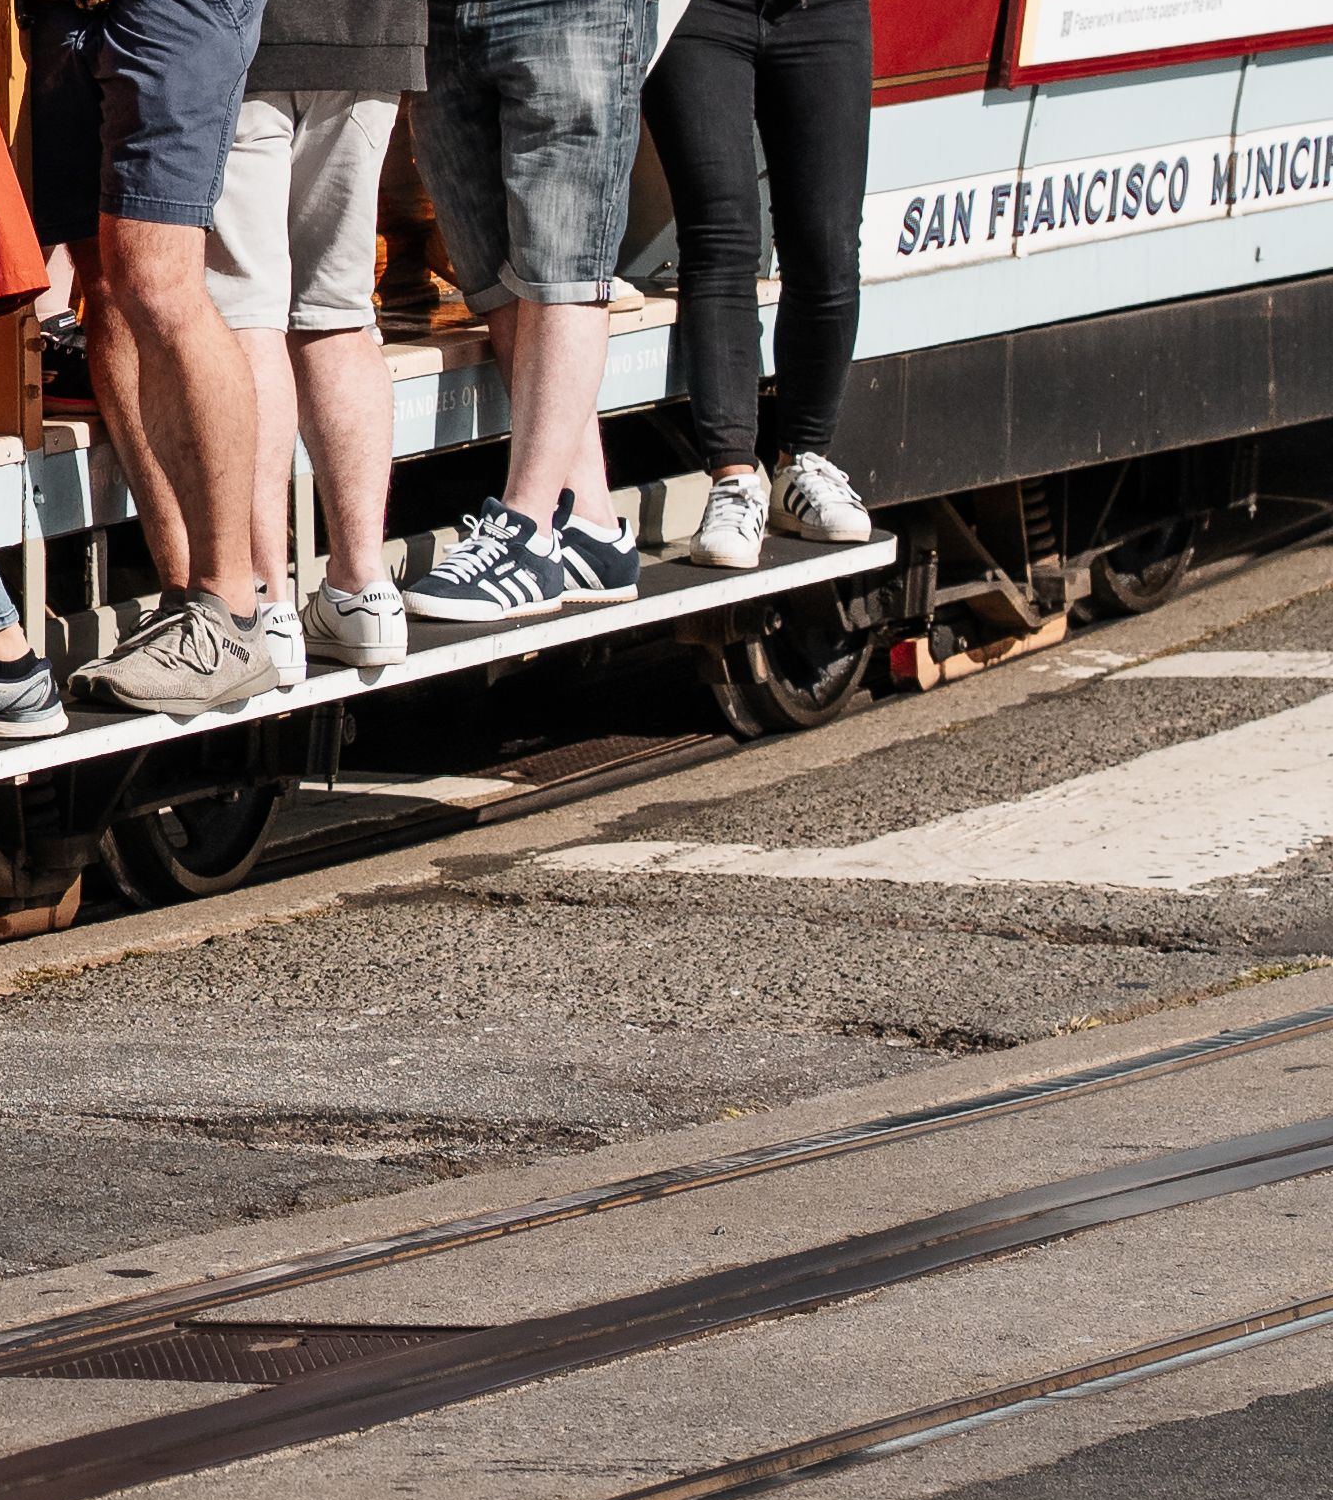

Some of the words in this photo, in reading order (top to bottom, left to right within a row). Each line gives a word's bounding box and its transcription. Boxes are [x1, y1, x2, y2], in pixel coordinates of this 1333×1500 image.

[897, 188, 975, 256] SAN
[986, 156, 1189, 239] FRANCISCO
[221, 637, 250, 665] PUMA
